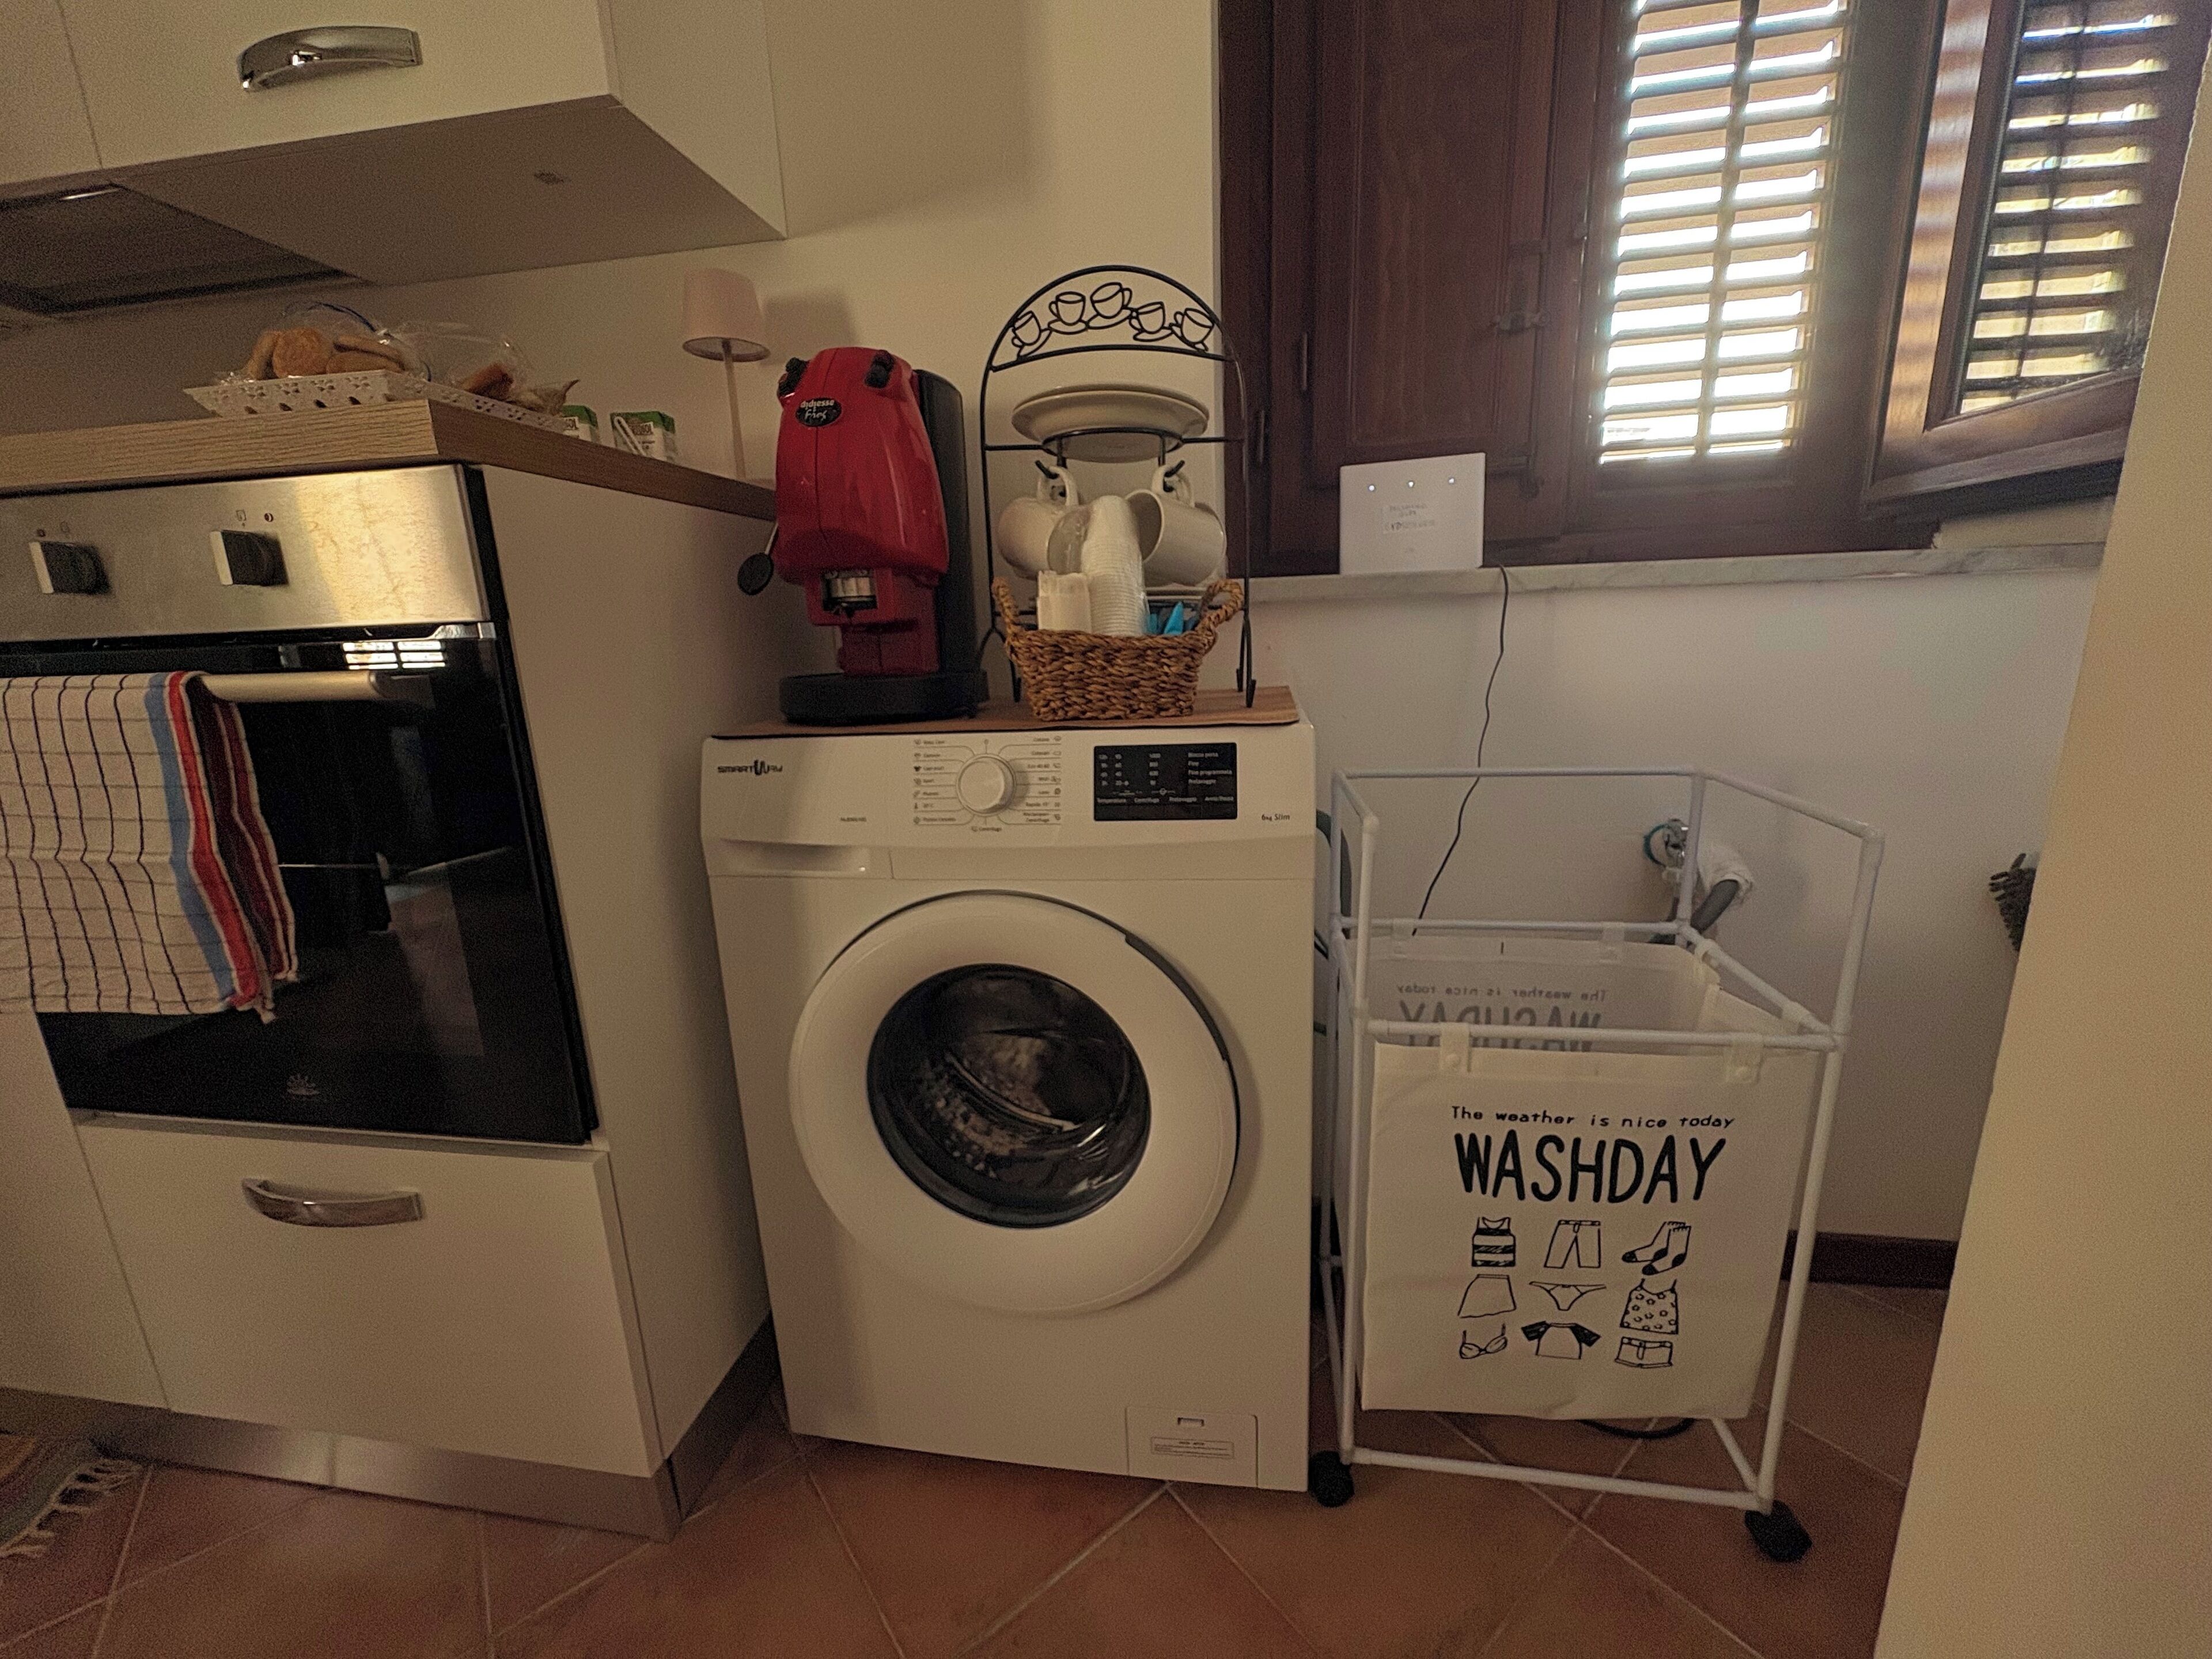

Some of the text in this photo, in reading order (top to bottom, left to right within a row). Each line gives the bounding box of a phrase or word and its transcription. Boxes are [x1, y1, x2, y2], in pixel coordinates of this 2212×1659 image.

[1274, 813, 1290, 821] Slim
[1452, 1105, 1736, 1129] The weather is nice today
[1455, 1129, 1726, 1205] WASHDAY
